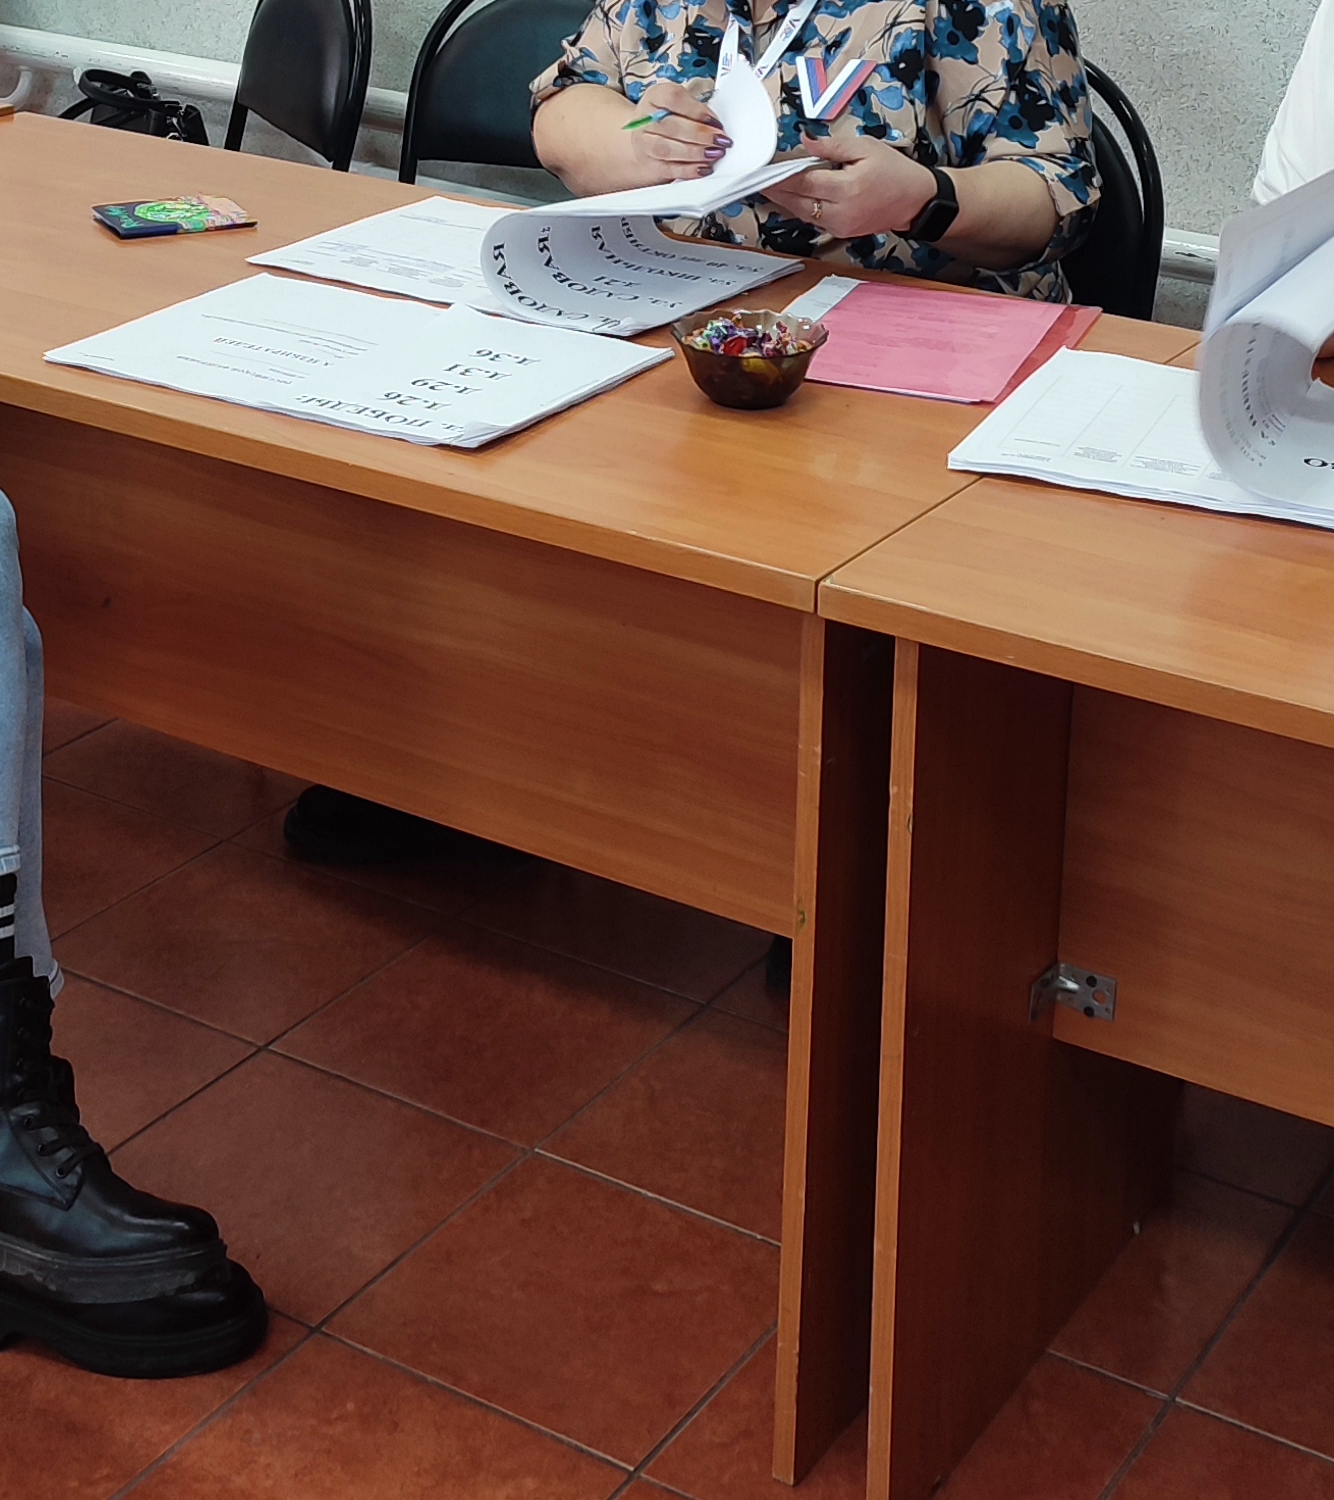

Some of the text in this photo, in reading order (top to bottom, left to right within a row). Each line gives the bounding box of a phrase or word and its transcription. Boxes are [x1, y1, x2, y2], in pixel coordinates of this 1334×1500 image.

[621, 216, 677, 260] ОКТЯБР
[493, 241, 590, 322] САДОВАЯ
[468, 349, 541, 366] д.36
[443, 364, 512, 381] д.31
[411, 378, 483, 396] д.29
[293, 394, 431, 429] ПОБЕДЫ:
[377, 391, 451, 412] д.26
